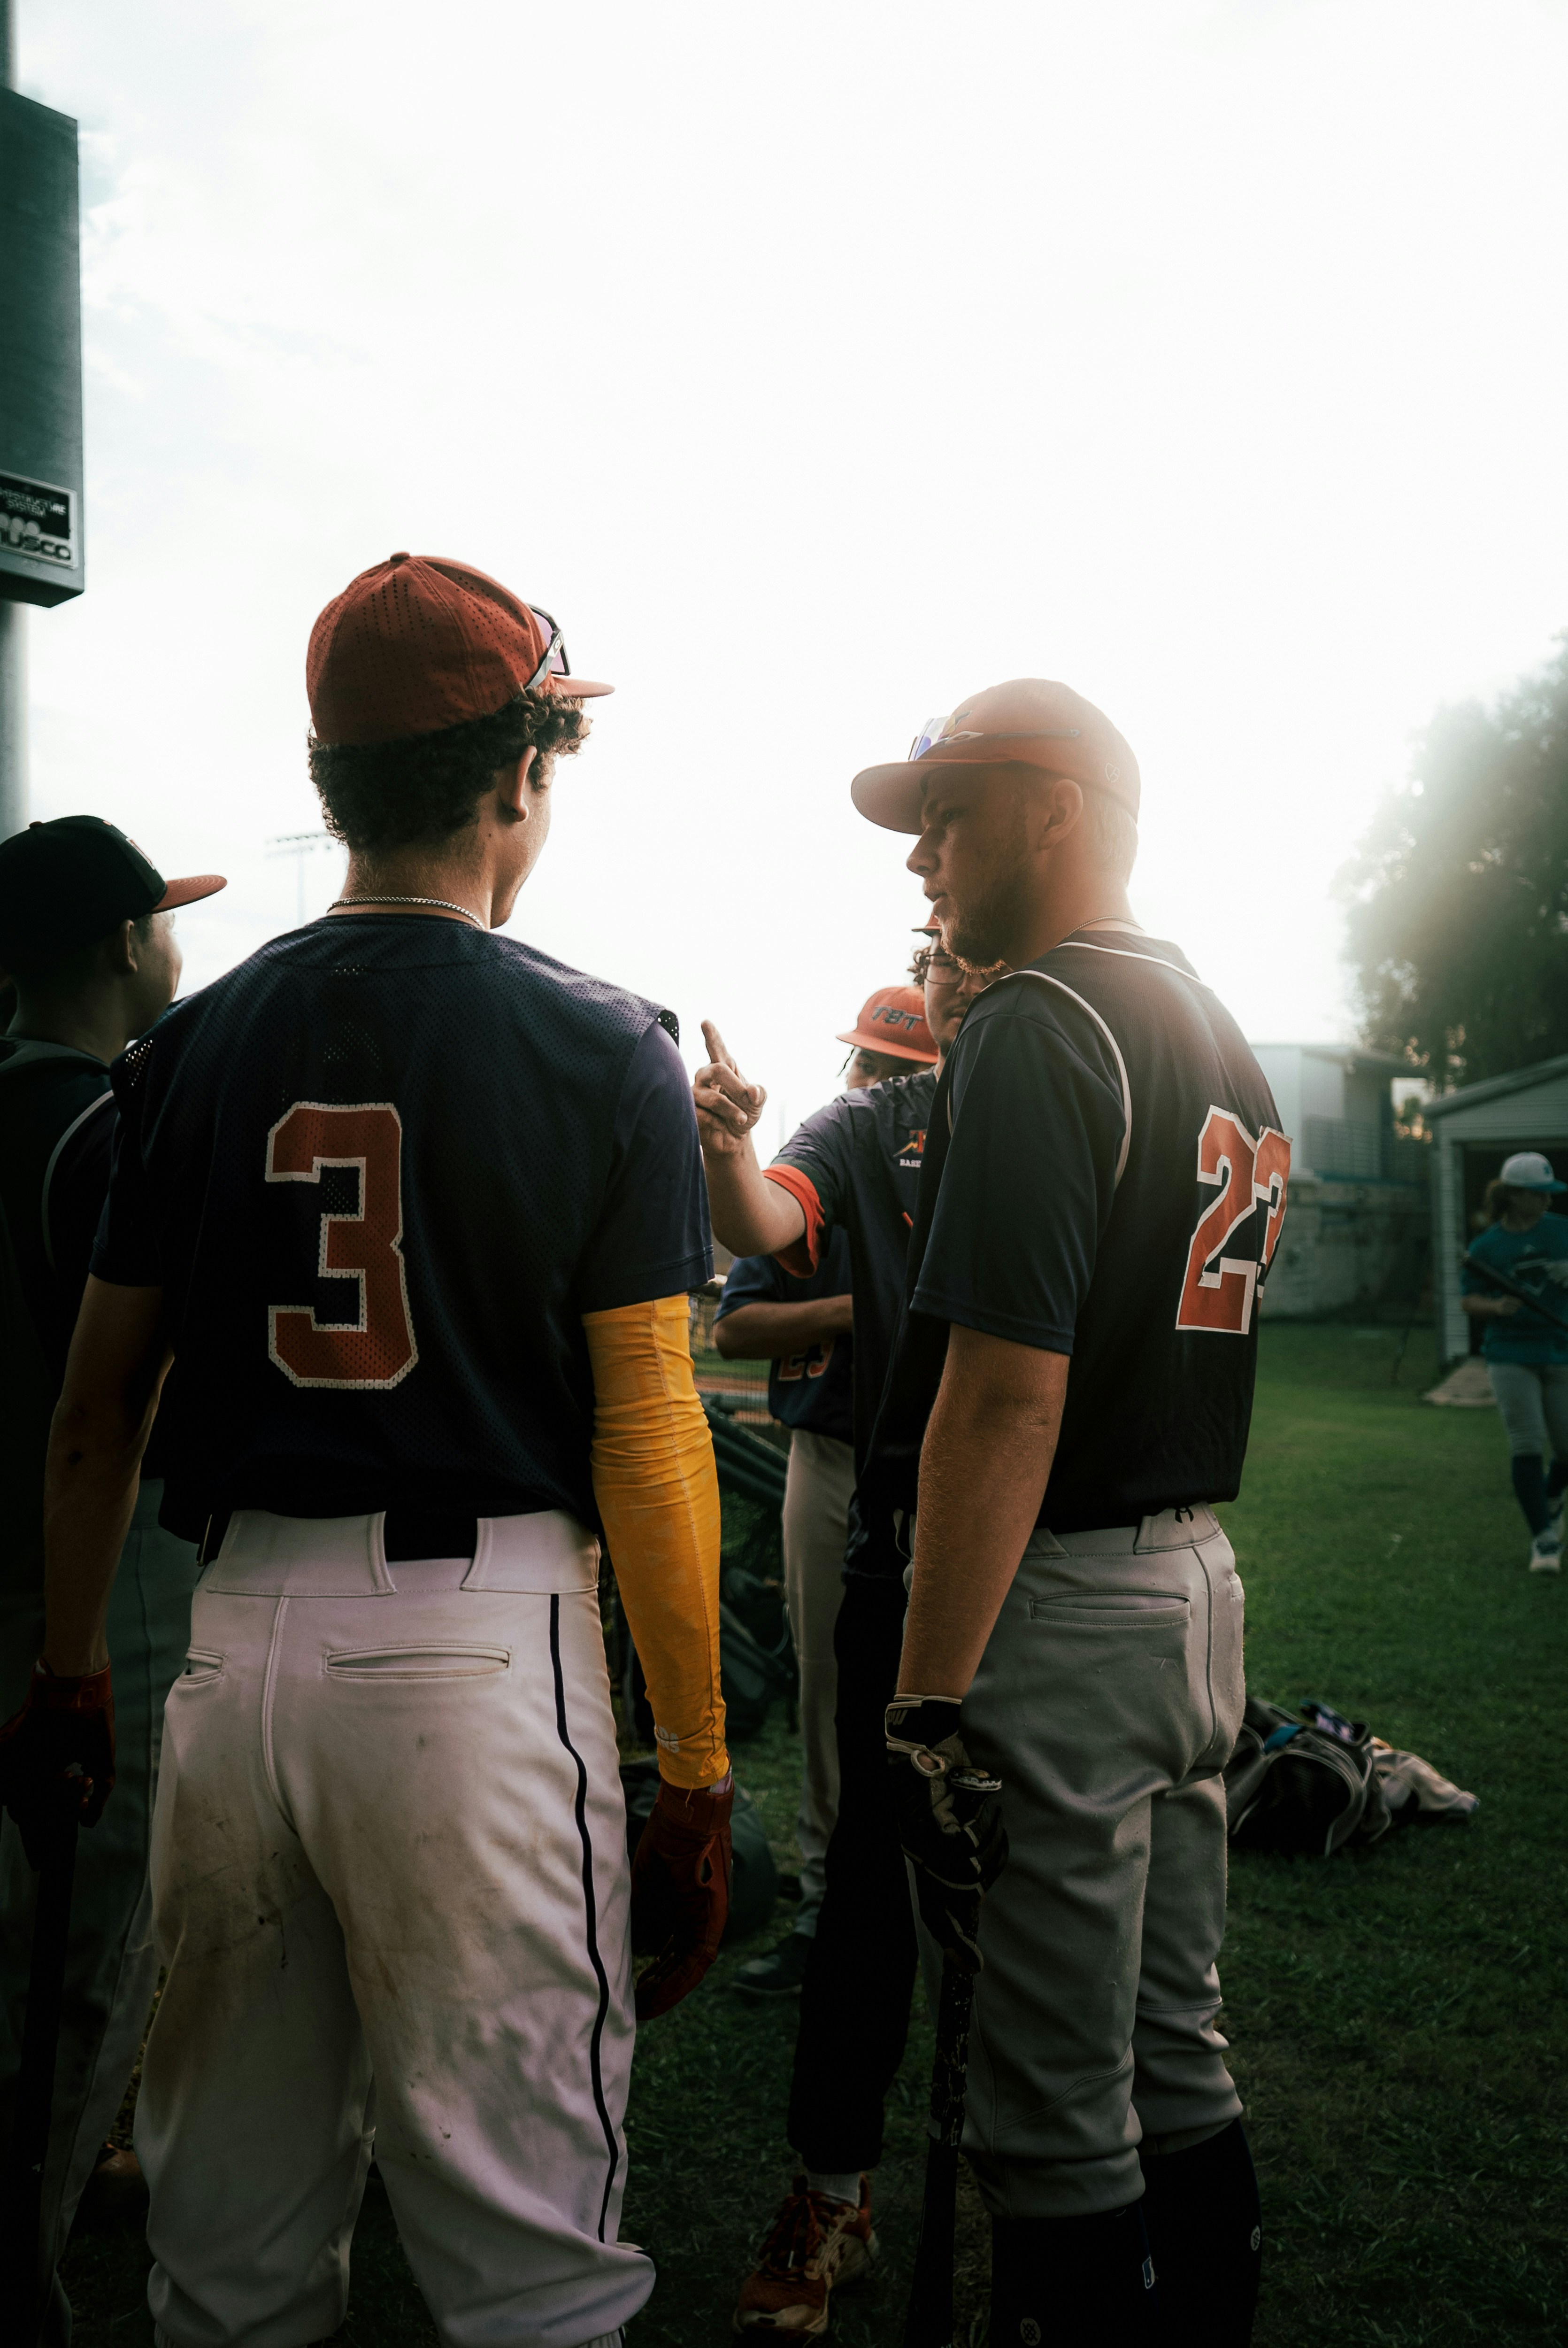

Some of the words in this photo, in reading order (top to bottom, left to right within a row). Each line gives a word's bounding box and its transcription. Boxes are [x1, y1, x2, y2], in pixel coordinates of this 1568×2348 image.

[872, 1005, 924, 1031] TBT
[265, 1101, 418, 1389] 3
[1176, 1104, 1293, 1335] 23
